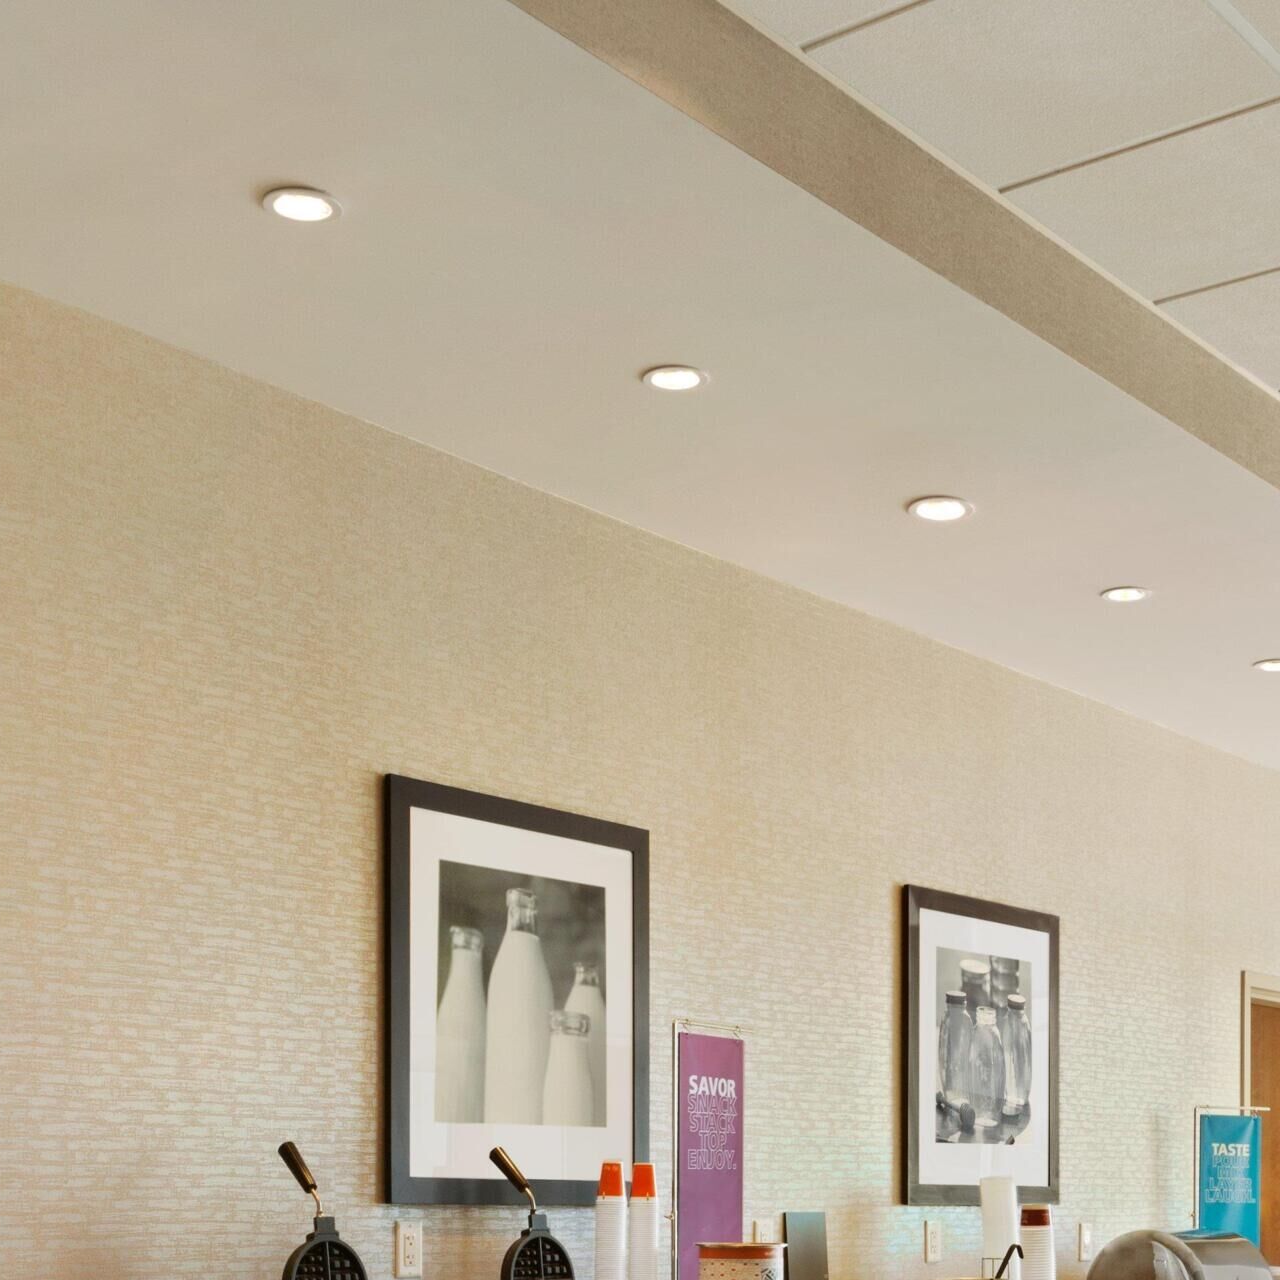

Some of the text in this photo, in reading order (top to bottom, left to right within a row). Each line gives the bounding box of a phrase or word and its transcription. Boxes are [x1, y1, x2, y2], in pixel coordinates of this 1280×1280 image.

[689, 1074, 736, 1098] SAVOR
[688, 1093, 737, 1115] SNACK
[689, 1113, 736, 1134] STACK
[699, 1131, 727, 1151] TOP
[1211, 1143, 1250, 1157] TASTE
[688, 1149, 737, 1170] ENJOY.
